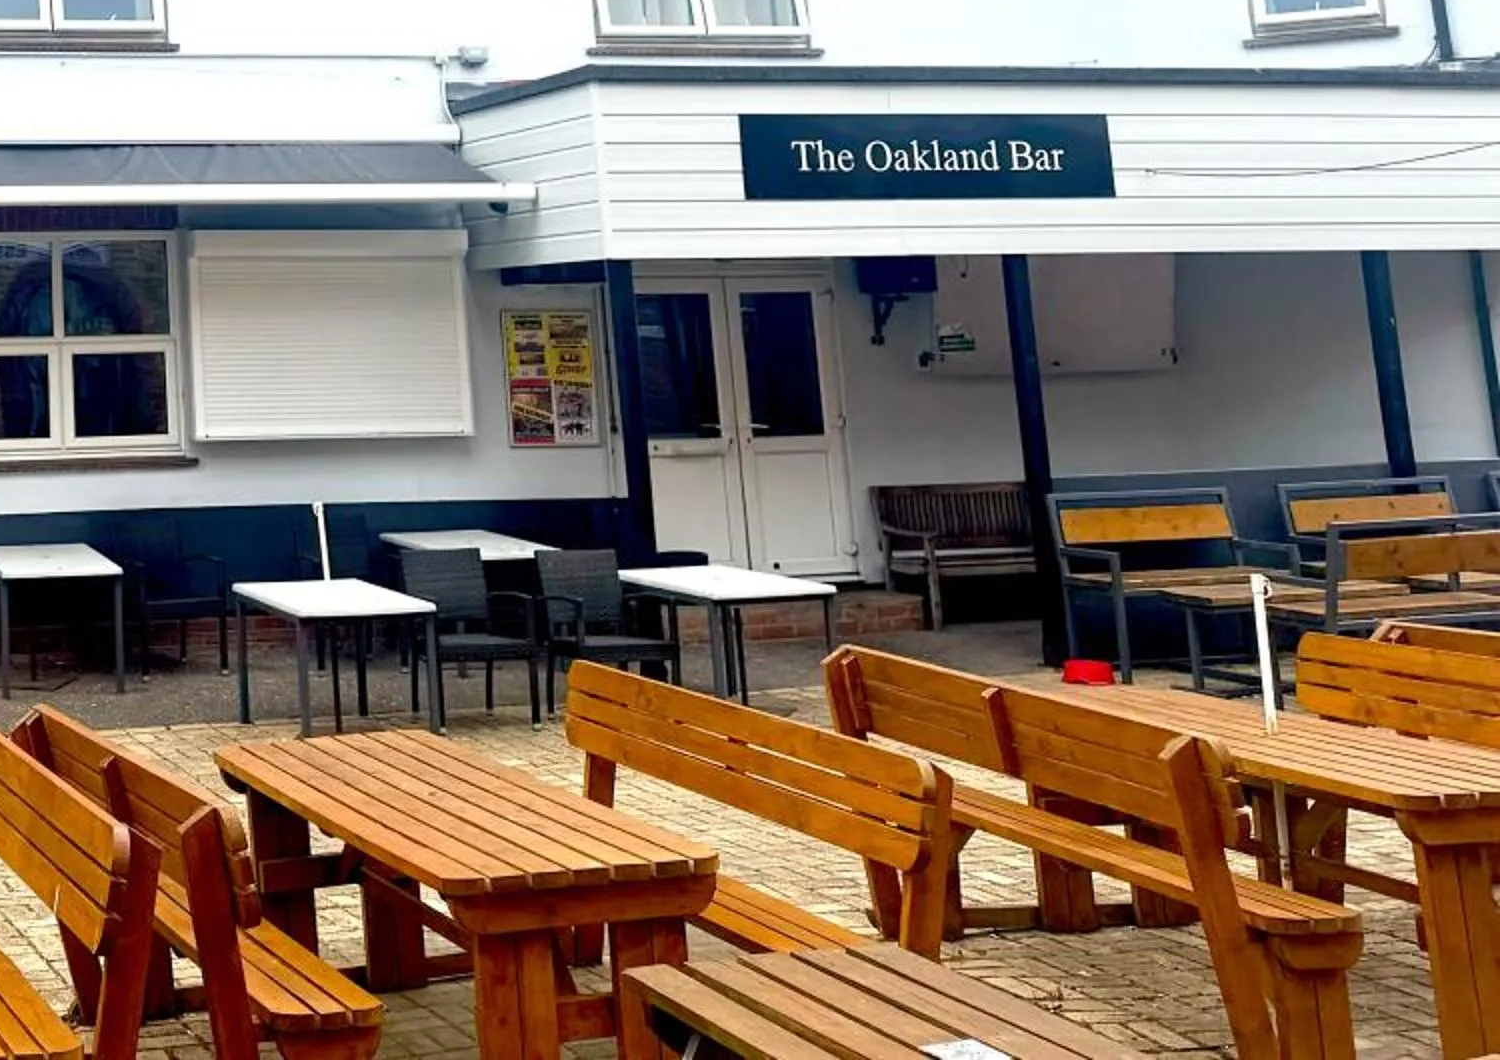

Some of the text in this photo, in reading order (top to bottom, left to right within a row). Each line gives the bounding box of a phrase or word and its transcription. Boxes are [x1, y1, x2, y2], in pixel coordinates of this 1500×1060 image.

[791, 139, 1065, 172] The Oakland Bar
